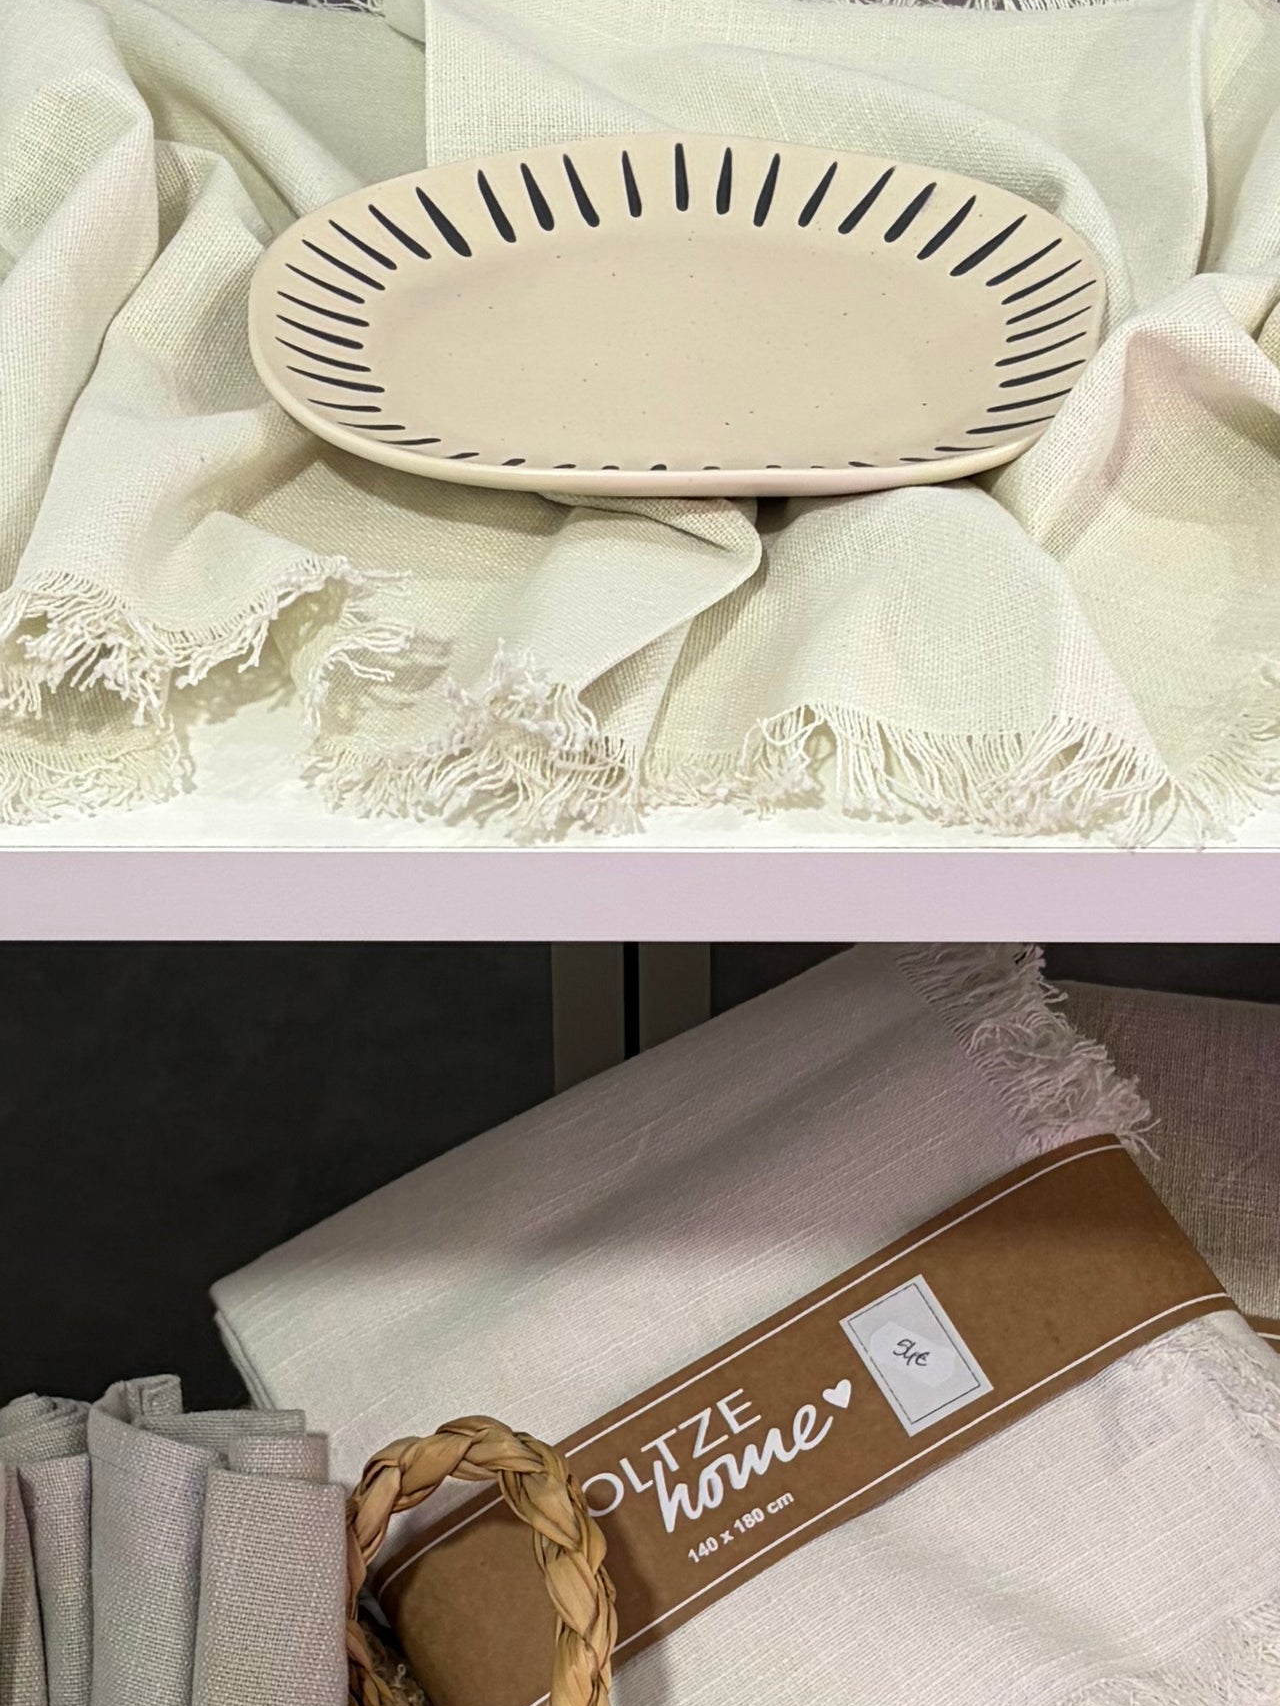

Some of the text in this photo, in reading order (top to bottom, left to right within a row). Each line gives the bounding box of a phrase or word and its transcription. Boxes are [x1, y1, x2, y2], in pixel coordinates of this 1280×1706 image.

[581, 1388, 762, 1518] OLTZE
[653, 1404, 834, 1533] home
[687, 1492, 795, 1564] 140 x 180 cm
